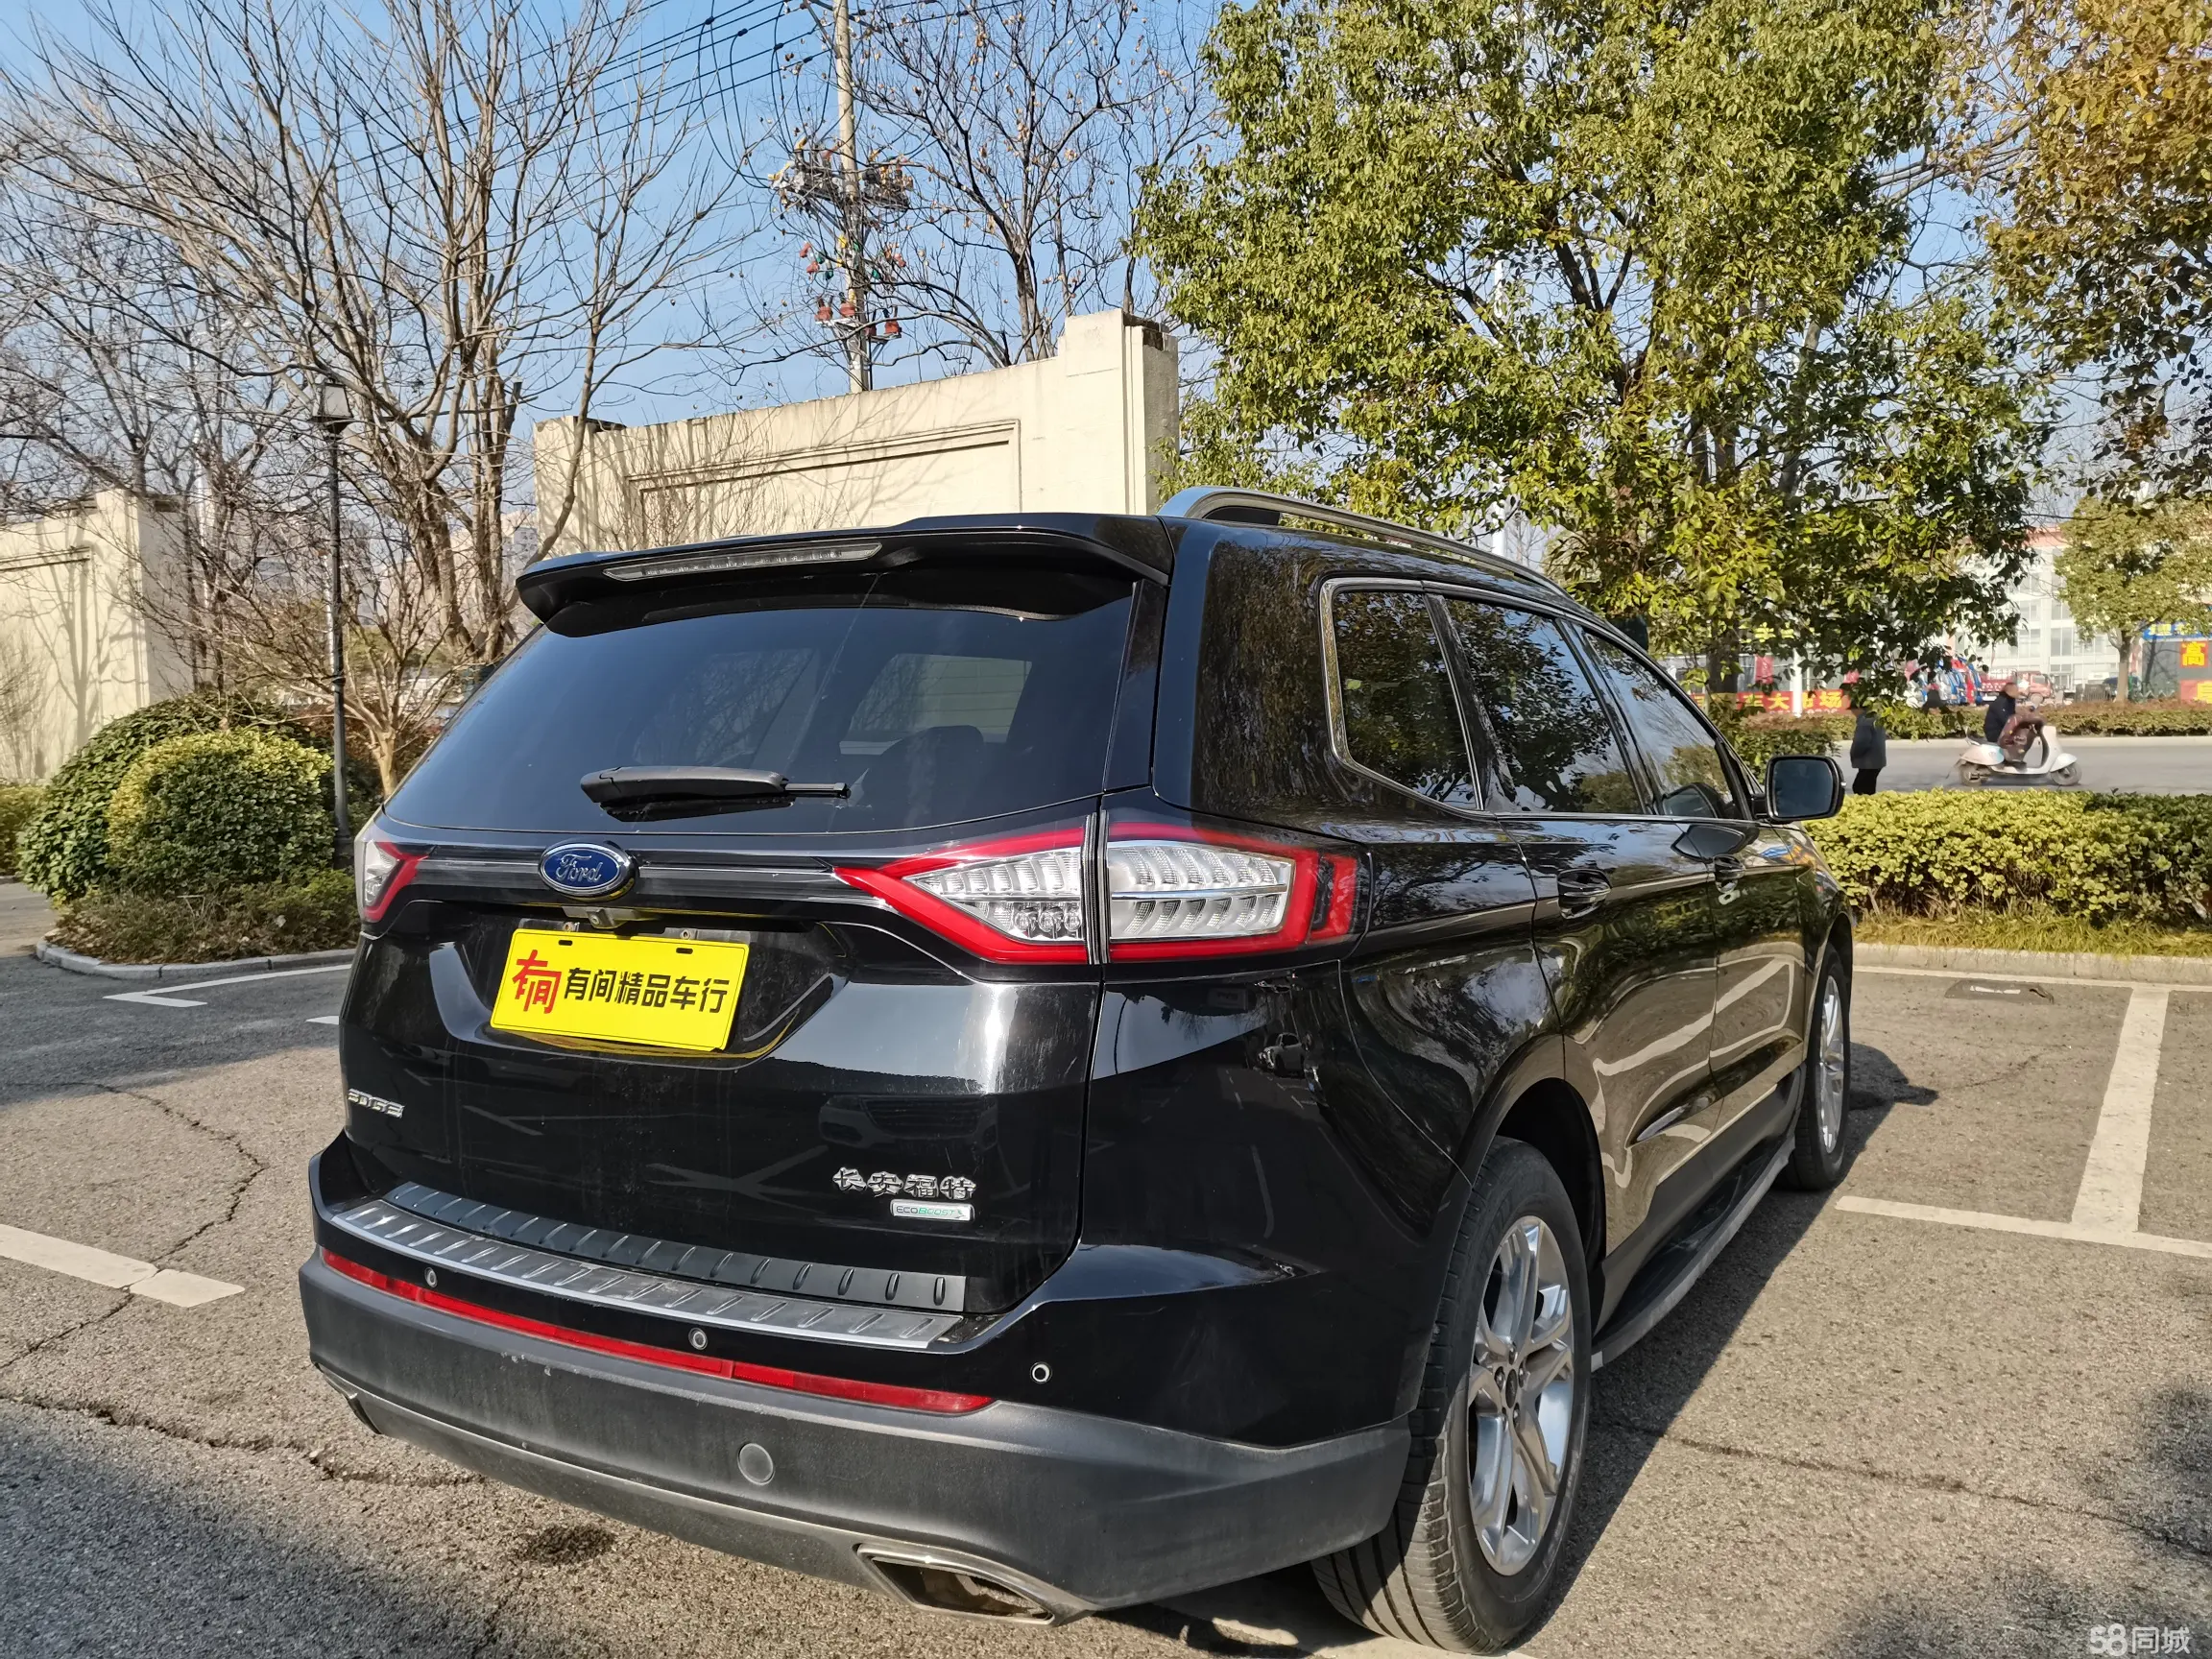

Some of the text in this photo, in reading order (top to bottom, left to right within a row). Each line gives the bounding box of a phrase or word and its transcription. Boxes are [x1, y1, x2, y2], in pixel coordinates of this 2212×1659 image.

[2181, 640, 2206, 666] 高
[555, 853, 603, 884] Ford
[564, 967, 730, 1014] 有间精品车行
[832, 1166, 976, 1200] 长安福特
